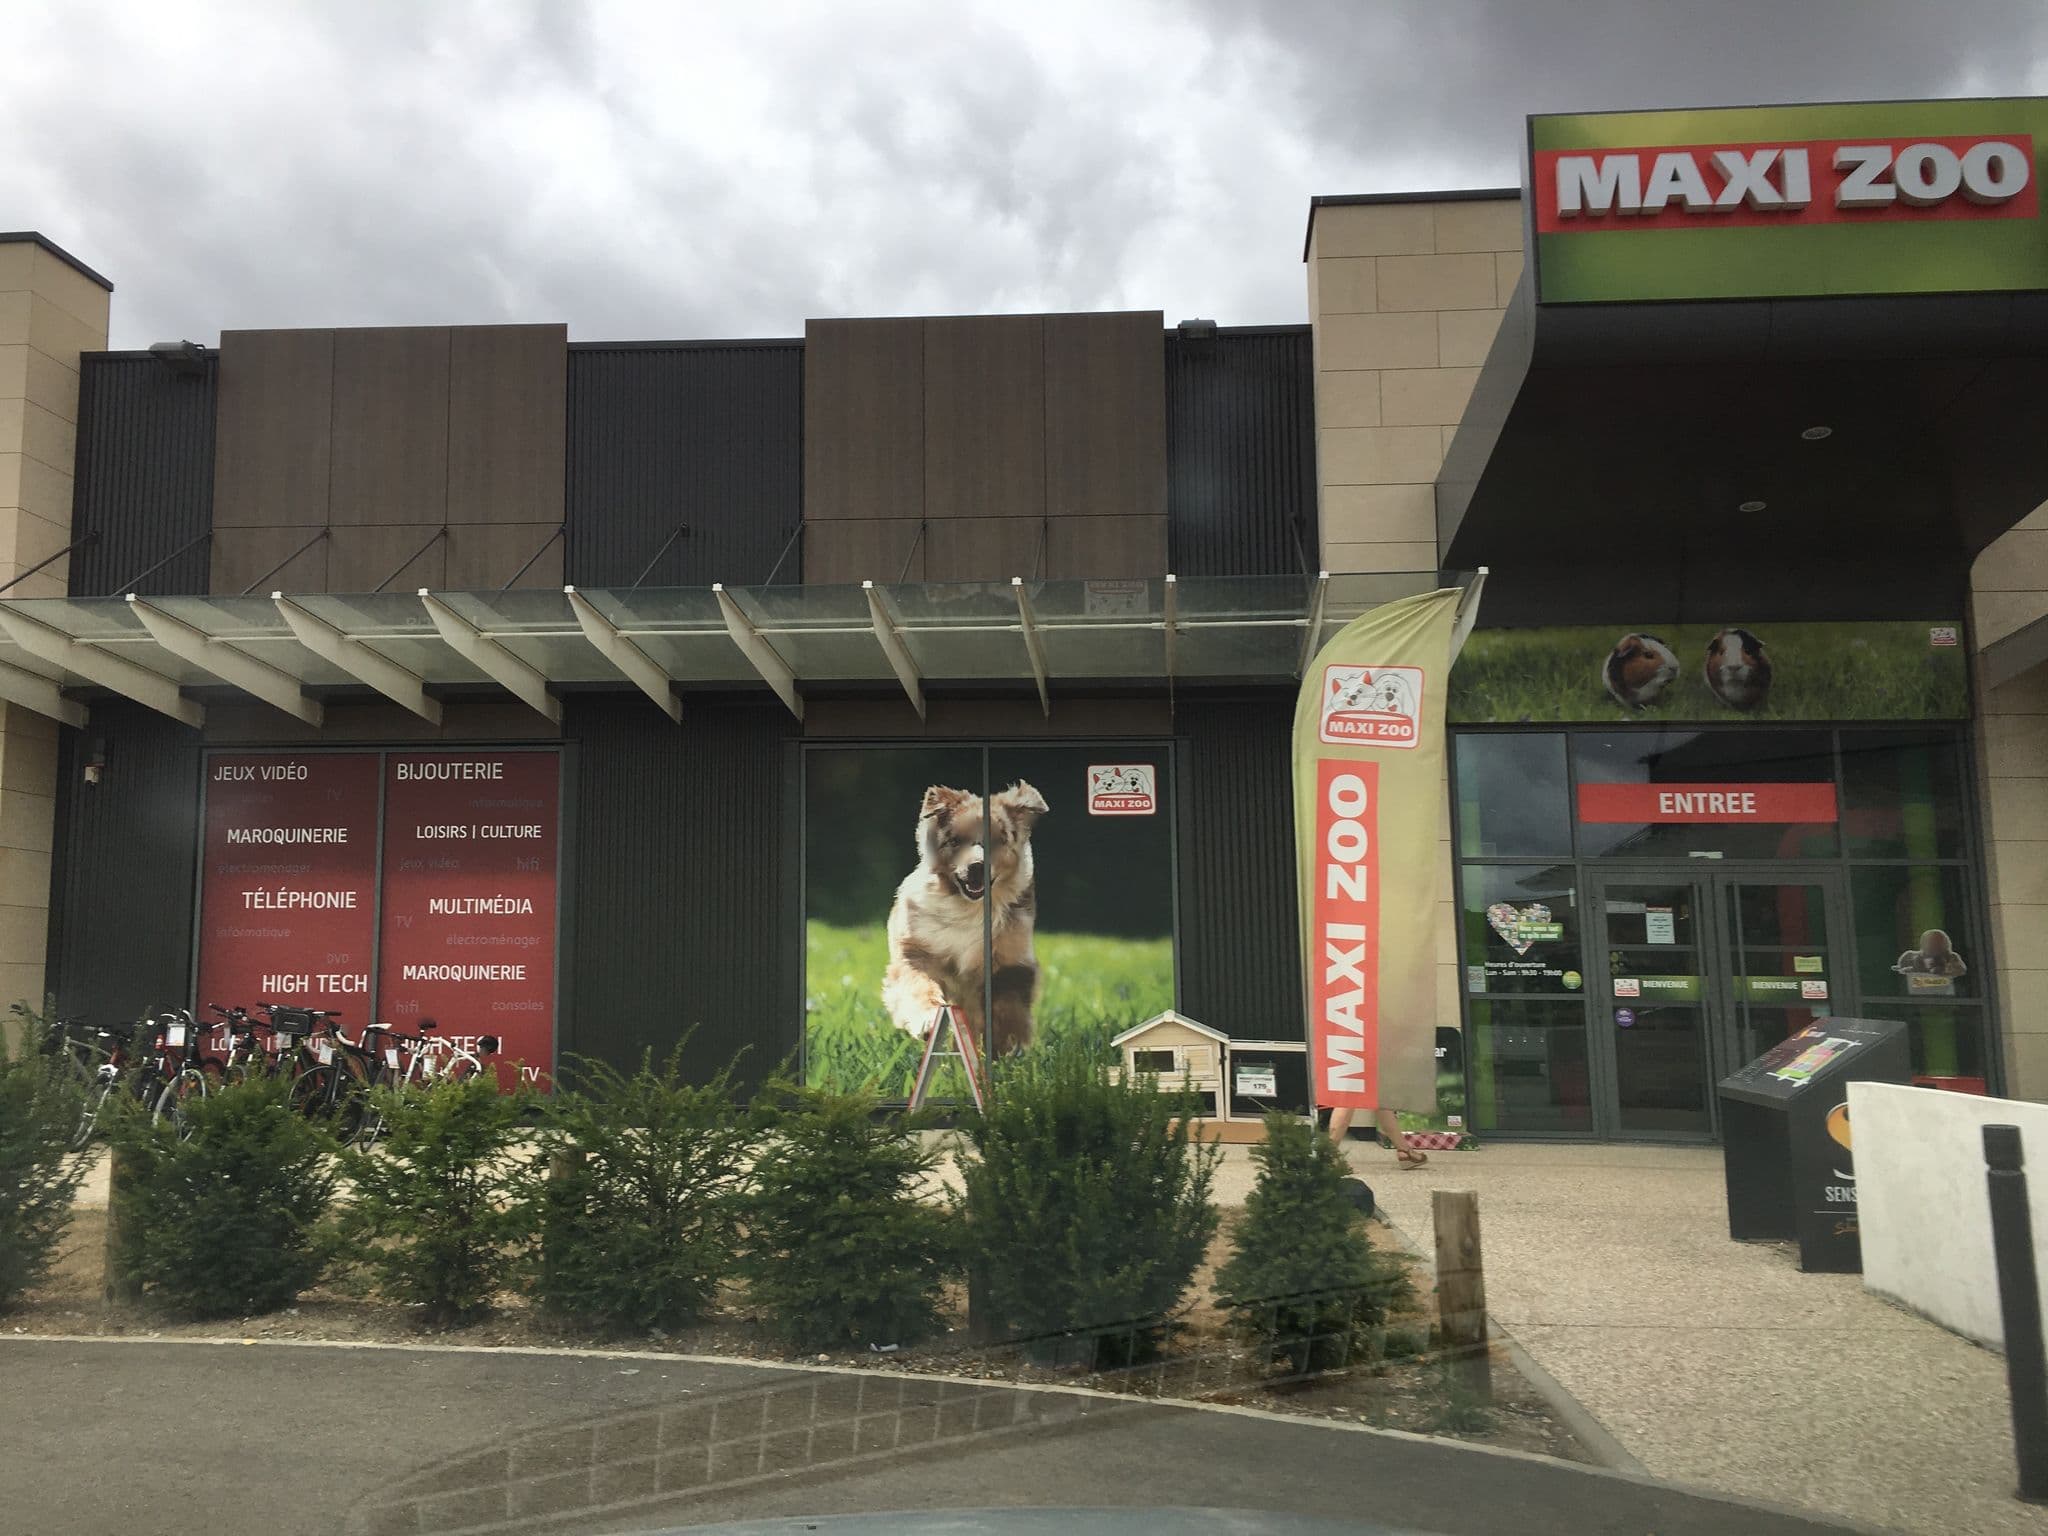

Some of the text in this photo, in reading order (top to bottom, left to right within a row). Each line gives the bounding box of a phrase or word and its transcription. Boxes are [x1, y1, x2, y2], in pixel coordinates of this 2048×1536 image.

[1556, 141, 2029, 217] MAXI ZOO
[1328, 721, 1412, 737] MAXI ZOO
[214, 761, 308, 781] JEUX VIDÉO
[396, 762, 504, 780] BIJOUTERIE
[1094, 800, 1151, 808] MAXI ZOO
[1659, 792, 1757, 814] ENTREE
[226, 828, 348, 844] MAROQUINERIE
[416, 825, 467, 839] LOISIRS
[480, 825, 542, 839] CULTURE
[242, 887, 357, 909] TÉLÉPHONIE
[429, 894, 533, 914] MULTIMÉDIA
[1326, 773, 1369, 1093] MAXI ZOO
[402, 965, 527, 982] MAROQUINERIE
[261, 974, 368, 993] HIGH TECH
